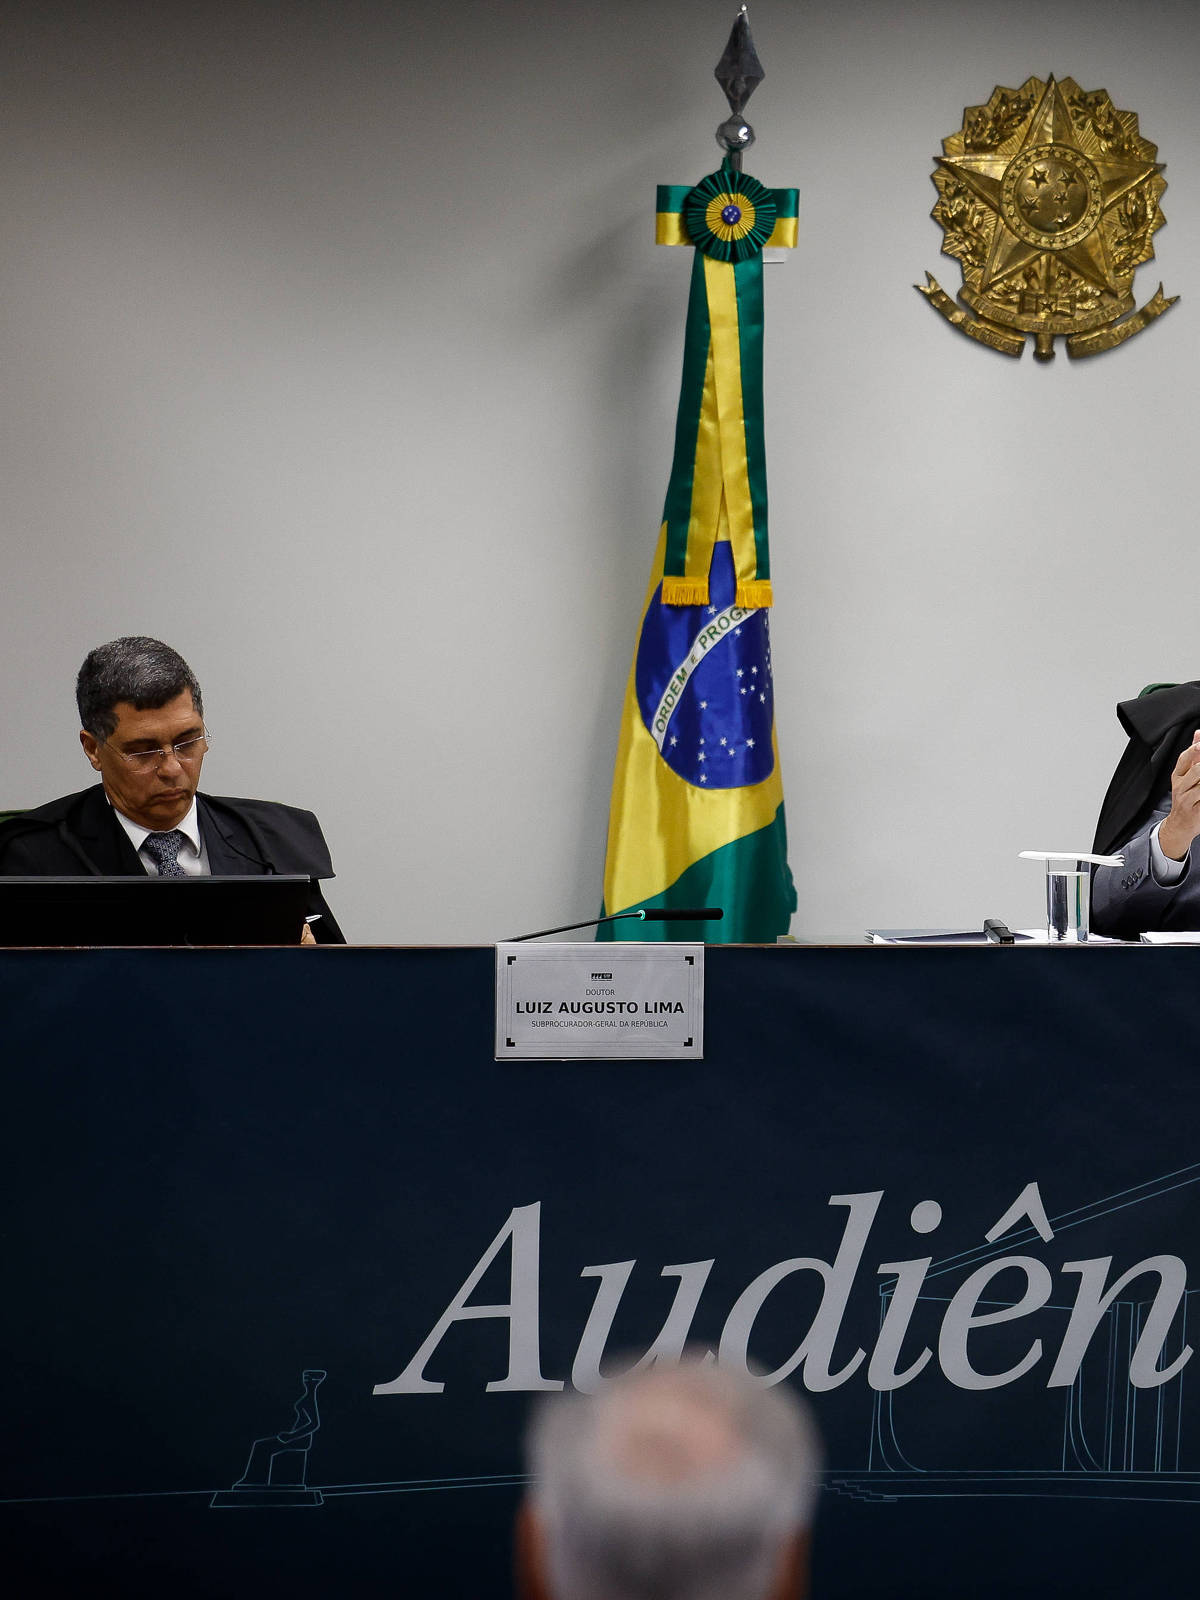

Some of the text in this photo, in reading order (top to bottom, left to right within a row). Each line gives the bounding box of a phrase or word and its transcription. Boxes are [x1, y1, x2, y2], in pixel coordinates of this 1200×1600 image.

[655, 667, 689, 733] ORDEM
[516, 1001, 685, 1014] LUIZ AUGUSTO LIMA
[531, 1019, 668, 1028] SUBPROCURADOR-GERAL DA REPÚBLICA
